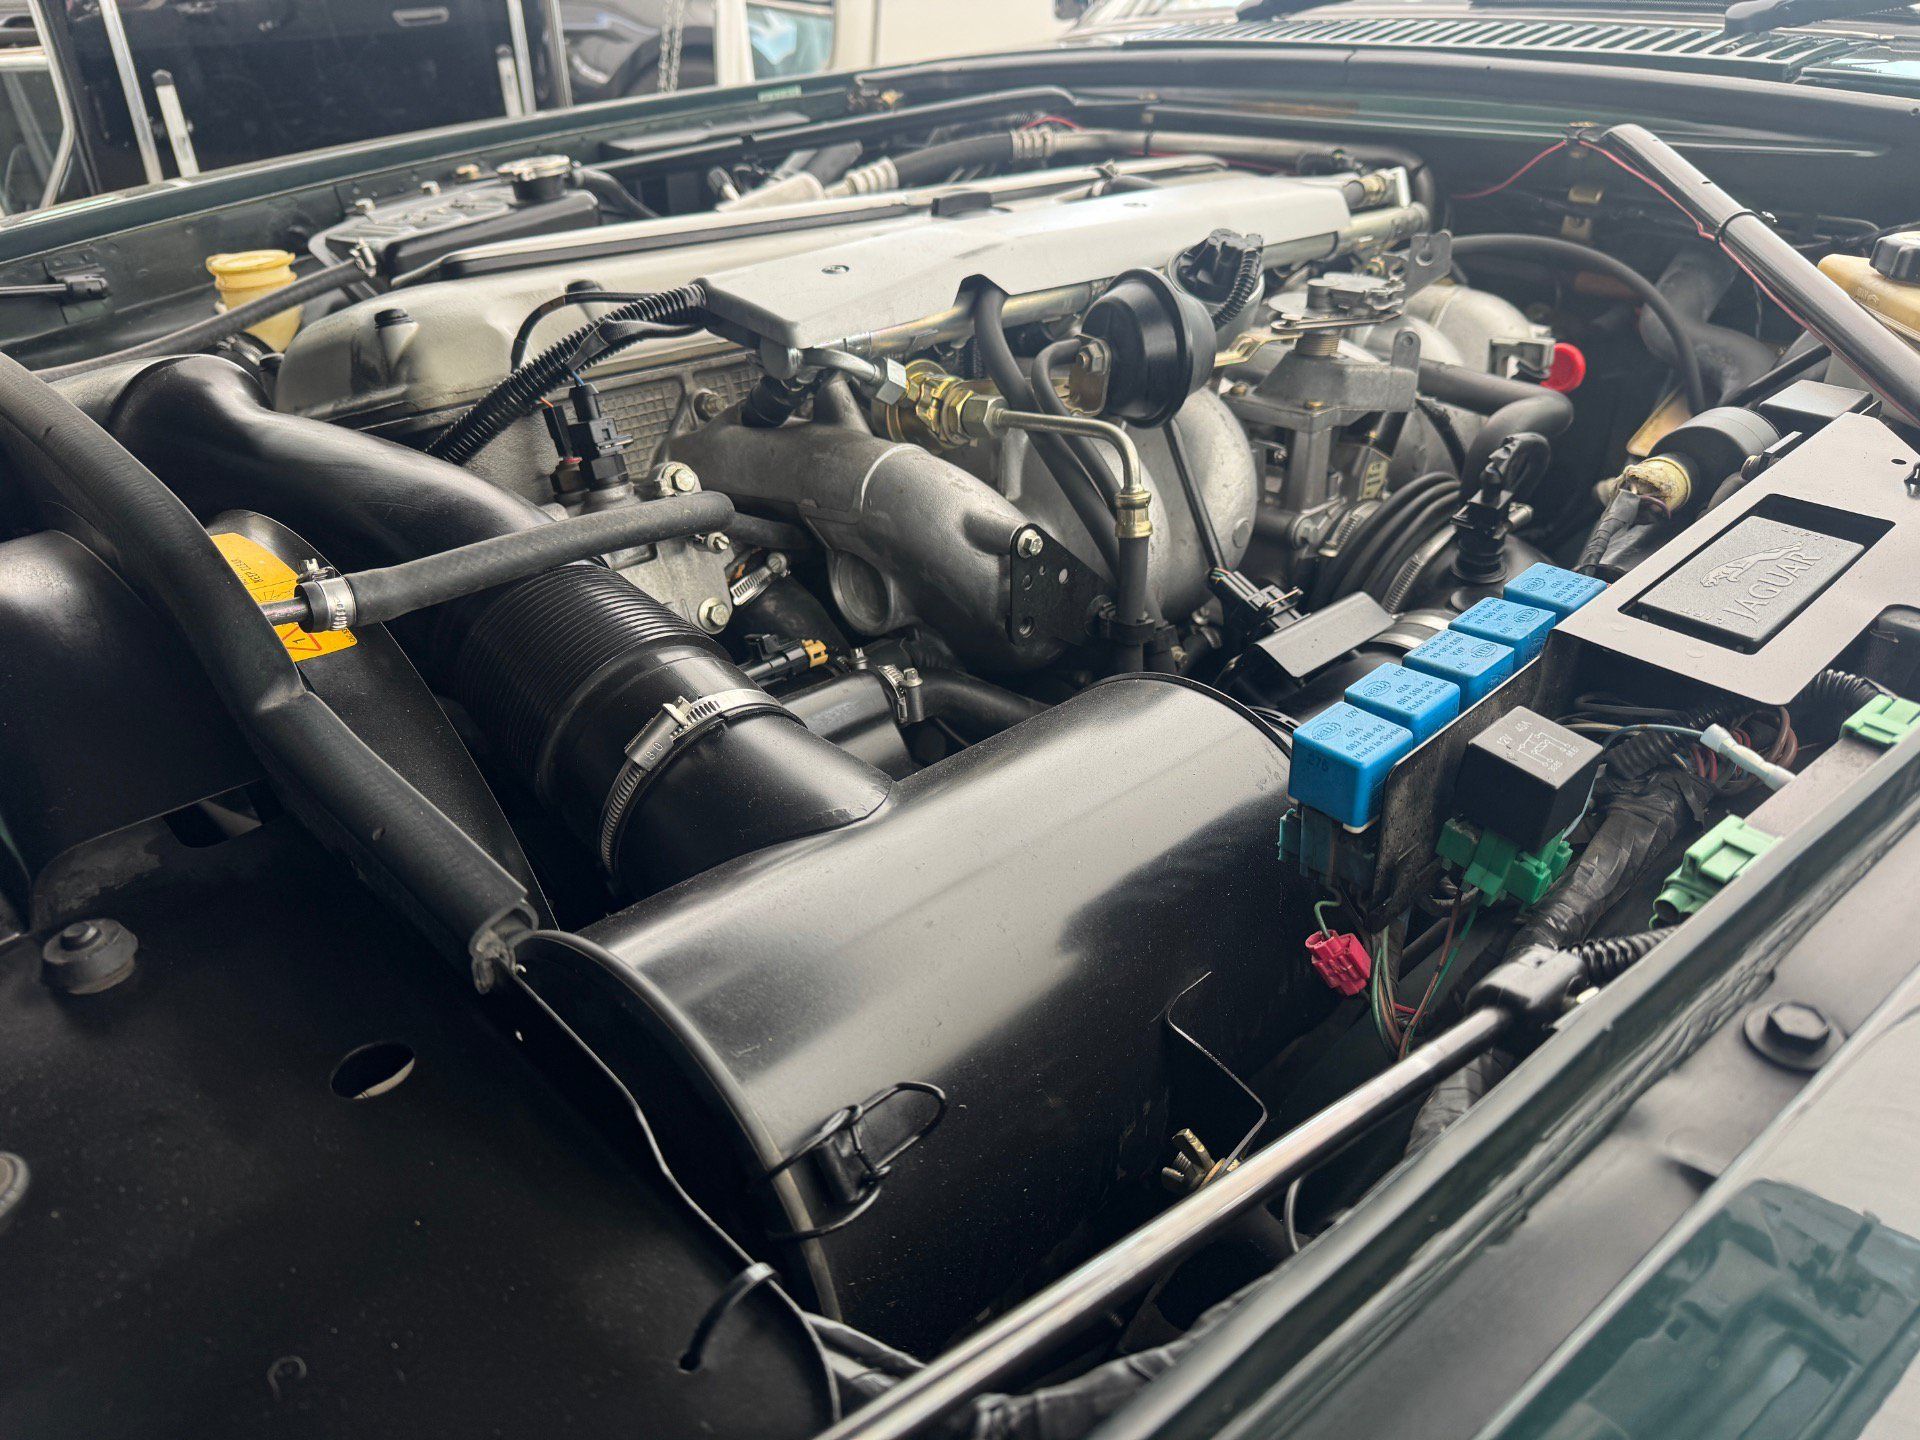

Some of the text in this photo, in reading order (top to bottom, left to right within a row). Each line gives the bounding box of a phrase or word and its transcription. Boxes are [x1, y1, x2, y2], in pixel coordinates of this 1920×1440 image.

[1722, 551, 1823, 623] JAGUAR
[1471, 643, 1498, 659] HELLA
[1363, 680, 1391, 698] HELLA
[1312, 722, 1342, 741] HELLA
[1496, 734, 1513, 746] 12V
[645, 742, 663, 760] 80
